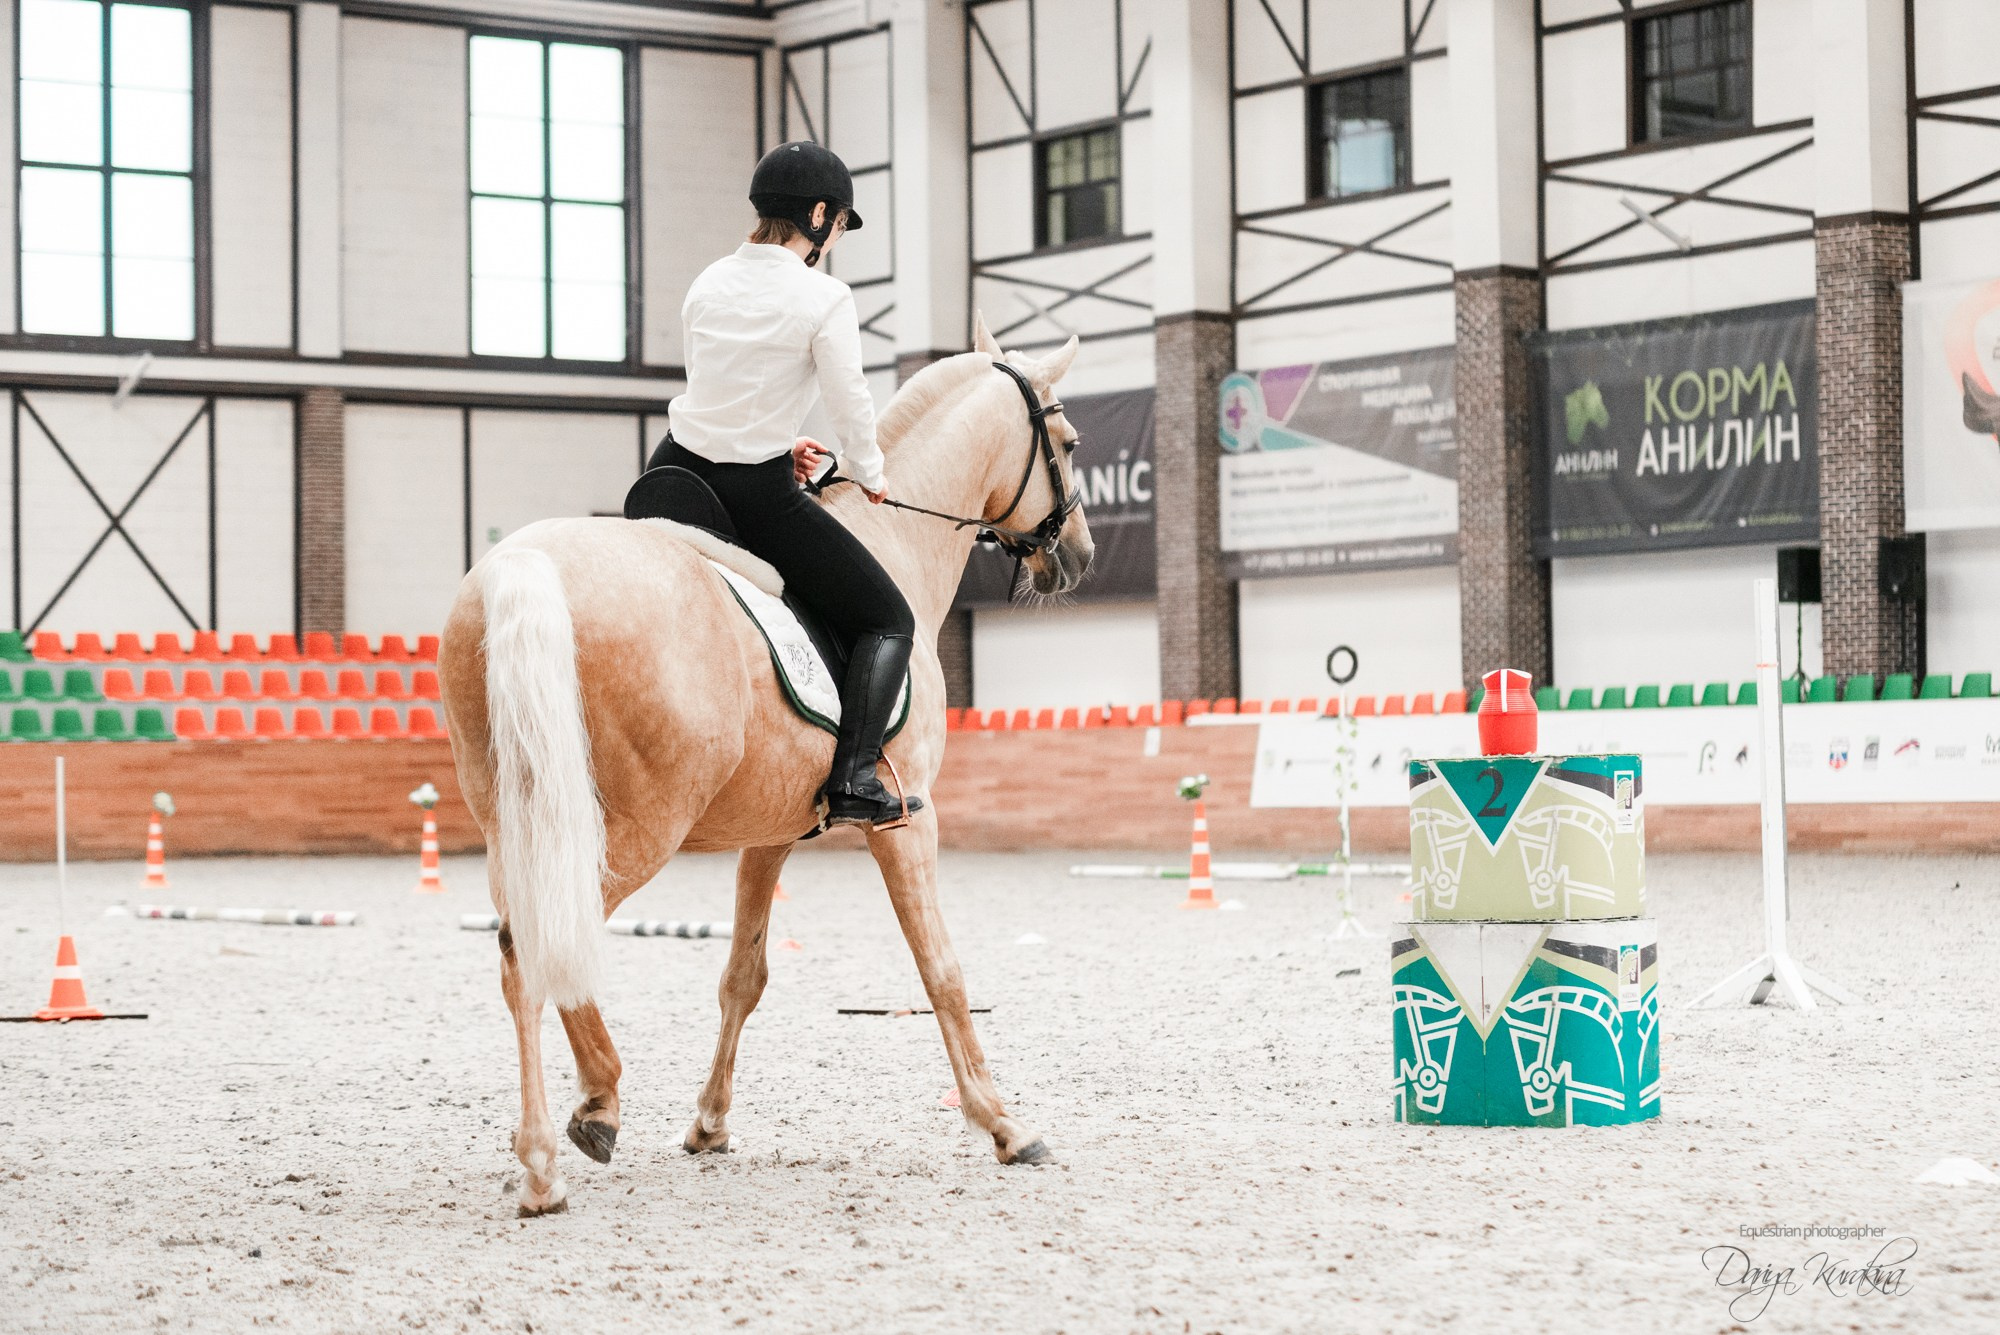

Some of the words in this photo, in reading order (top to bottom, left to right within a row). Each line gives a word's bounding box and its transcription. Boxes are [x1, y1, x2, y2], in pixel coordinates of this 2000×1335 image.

[1644, 359, 1797, 425] КОРМА
[1635, 412, 1801, 477] АНИЛИН
[1476, 767, 1508, 818] 2
